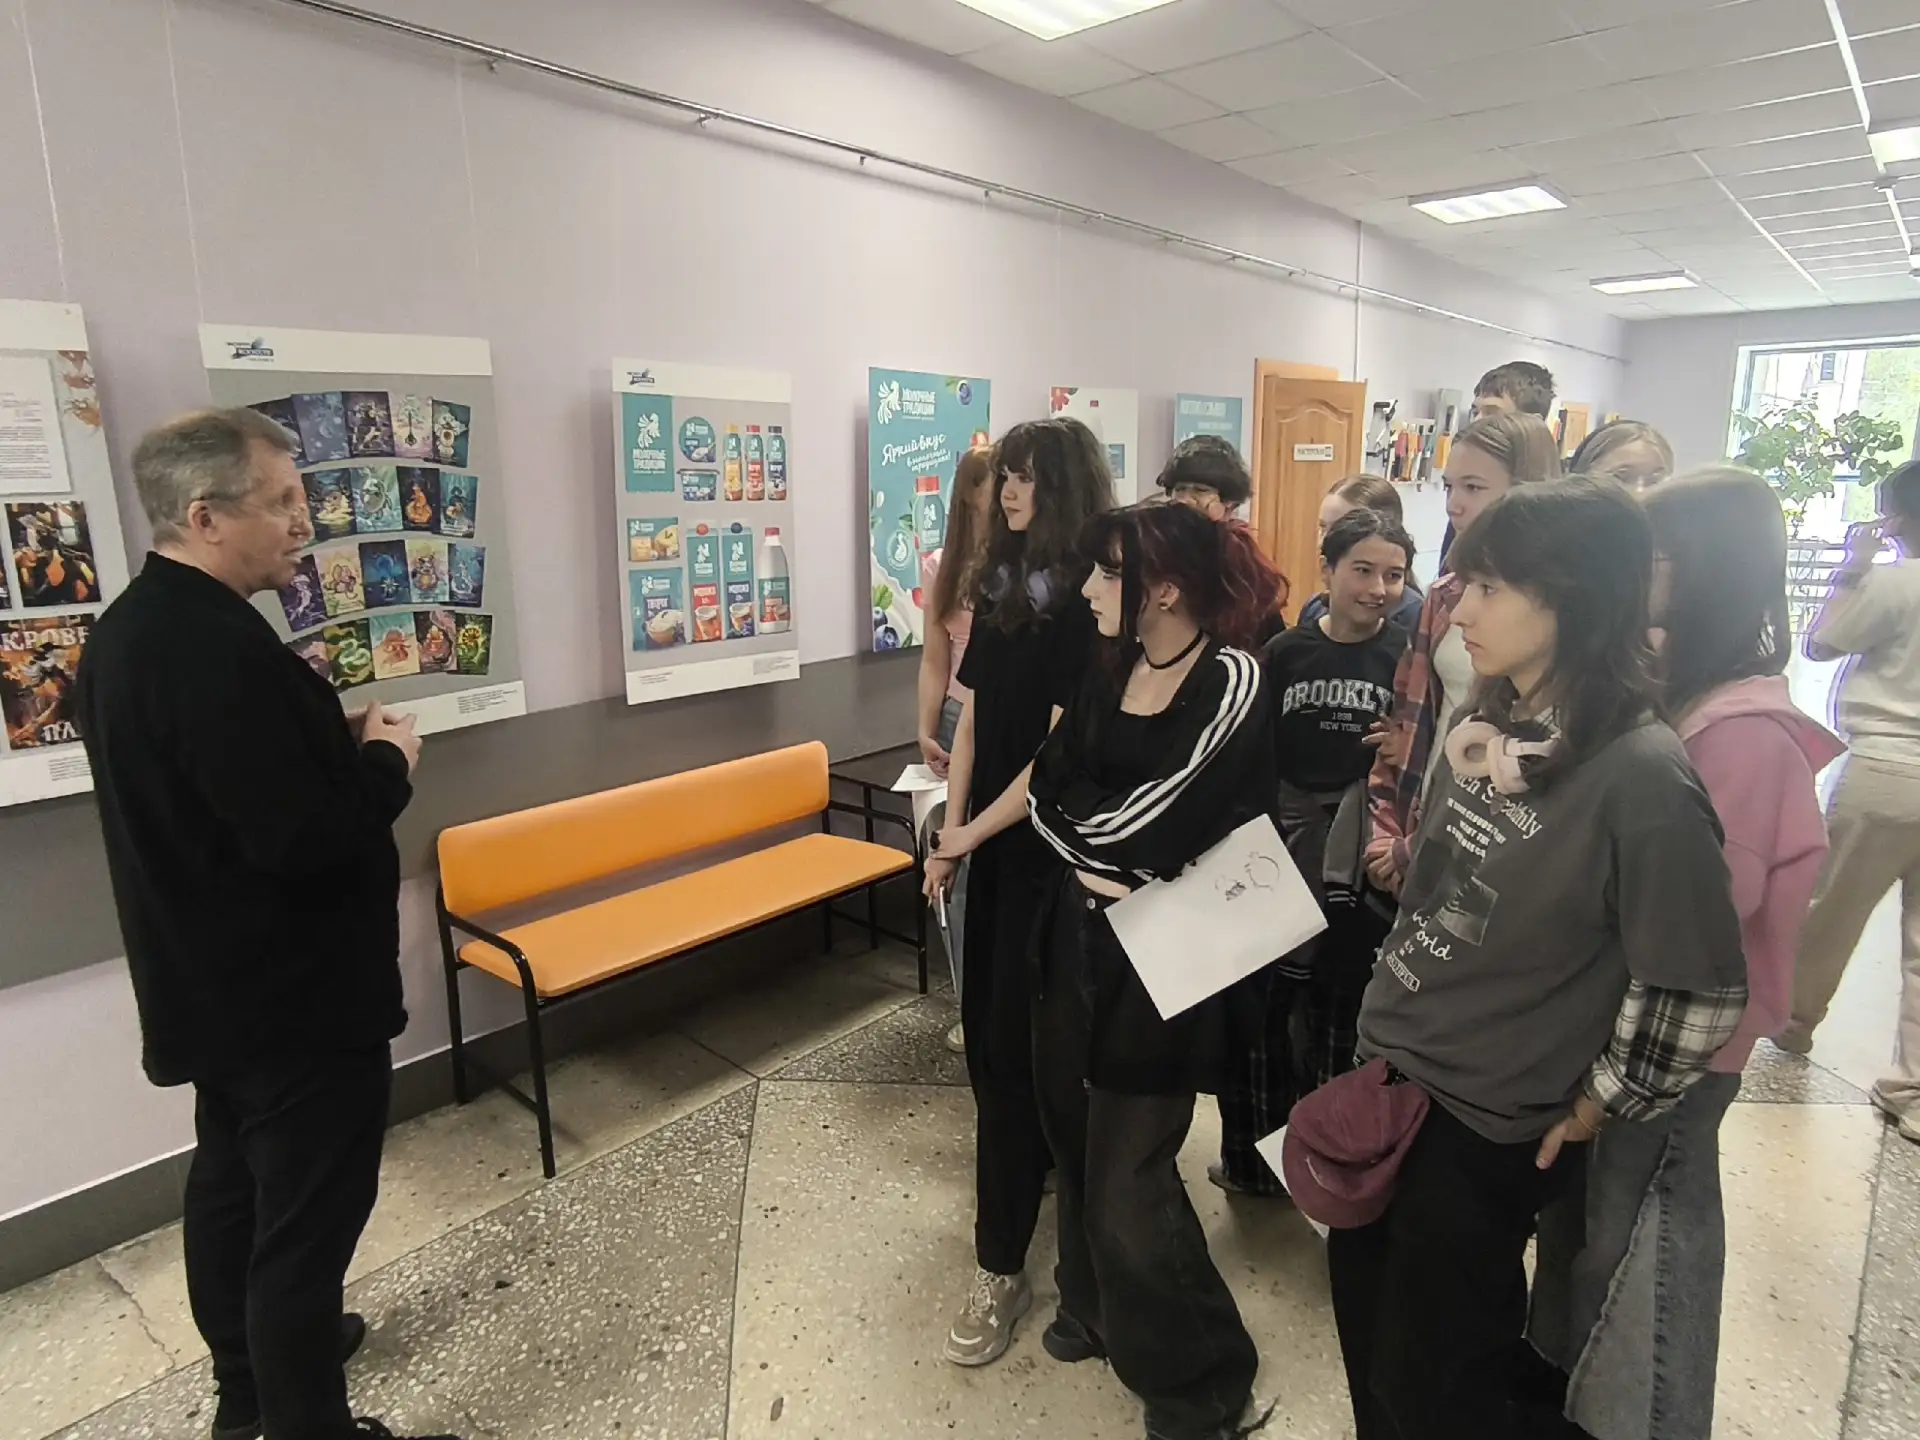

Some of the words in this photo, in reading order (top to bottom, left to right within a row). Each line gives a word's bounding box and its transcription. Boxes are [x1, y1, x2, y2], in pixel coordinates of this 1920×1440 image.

[881, 440, 919, 466] Яркий
[918, 434, 946, 451] вкус
[1281, 678, 1395, 717] BROOKLY
[1320, 721, 1339, 730] NEW
[1340, 722, 1363, 732] YORK
